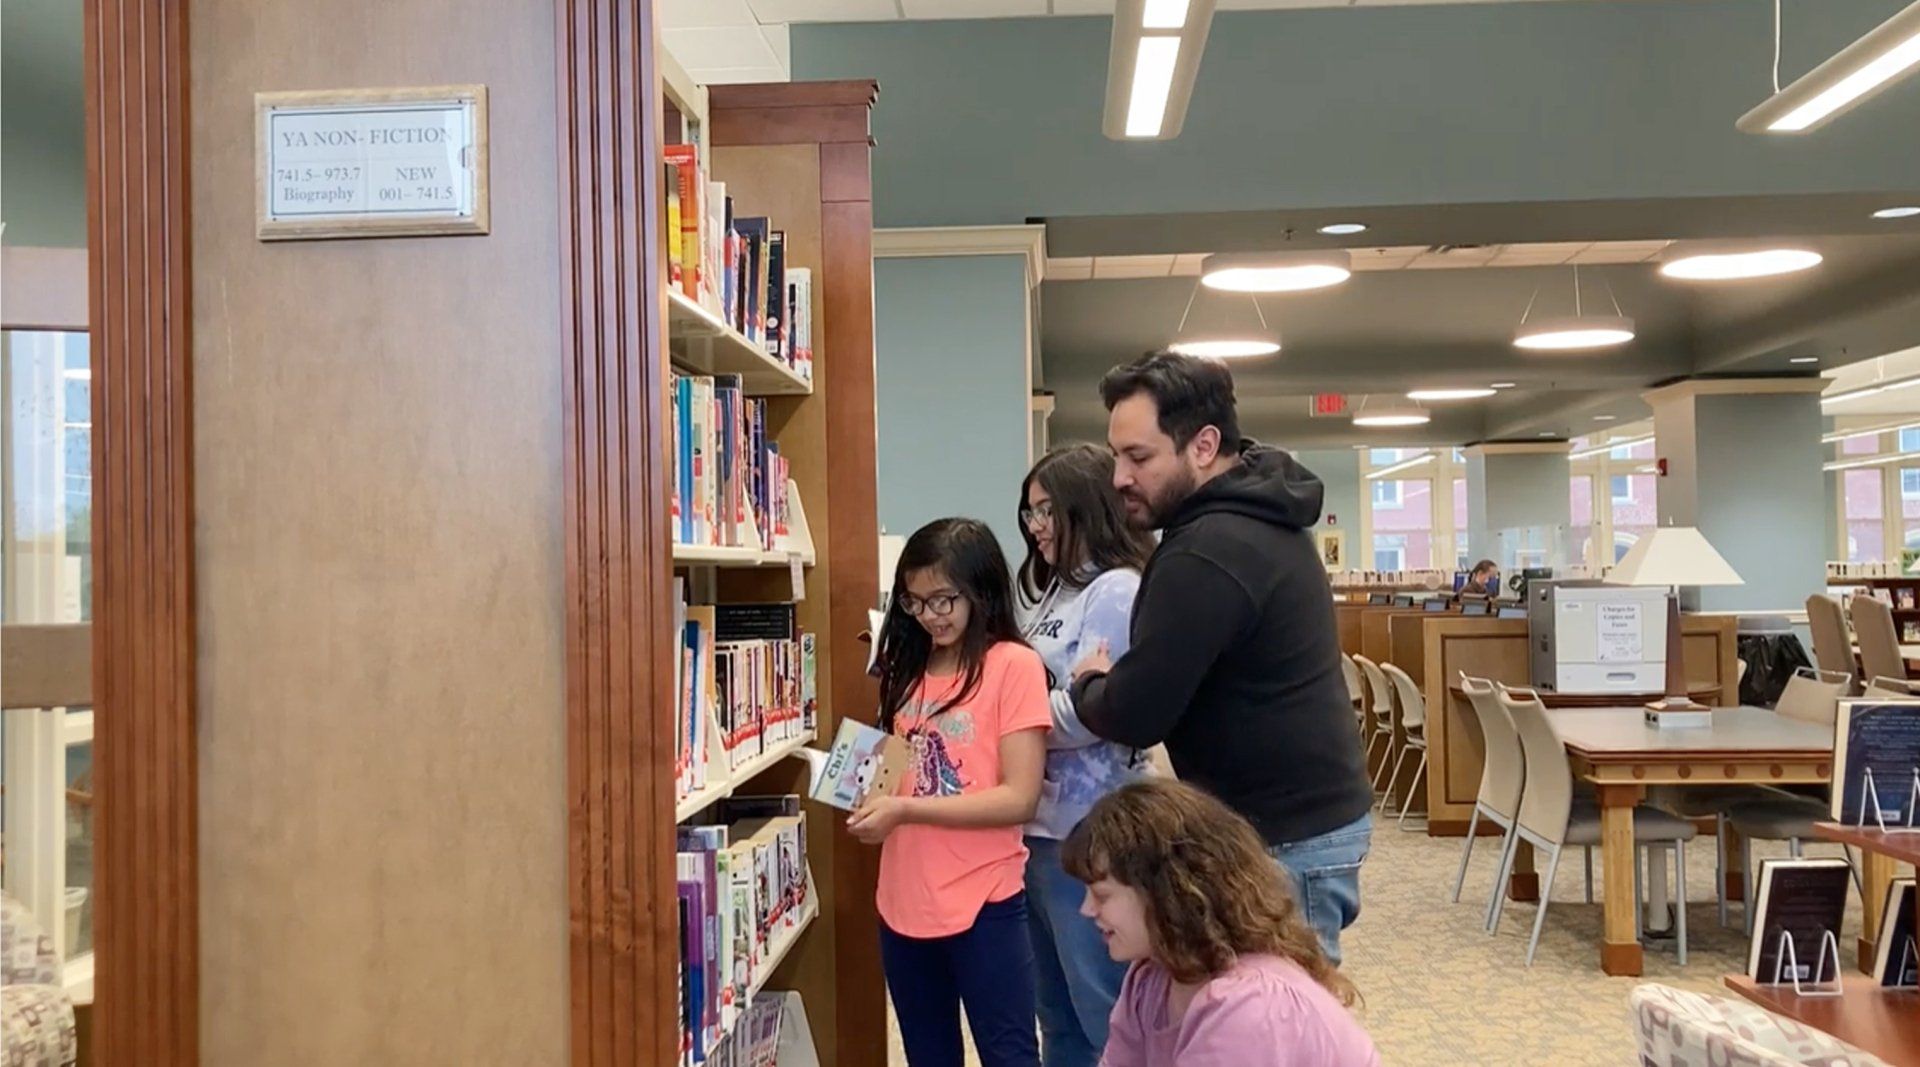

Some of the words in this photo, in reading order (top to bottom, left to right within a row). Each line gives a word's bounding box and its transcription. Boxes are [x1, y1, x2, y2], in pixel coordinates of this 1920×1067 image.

[282, 131, 309, 148] YA
[313, 129, 364, 146] NON-
[324, 167, 361, 181] 973.7
[395, 166, 438, 181] NEW
[284, 186, 354, 203] Biography
[418, 186, 453, 200] 741.5
[827, 743, 848, 779] Chi's
